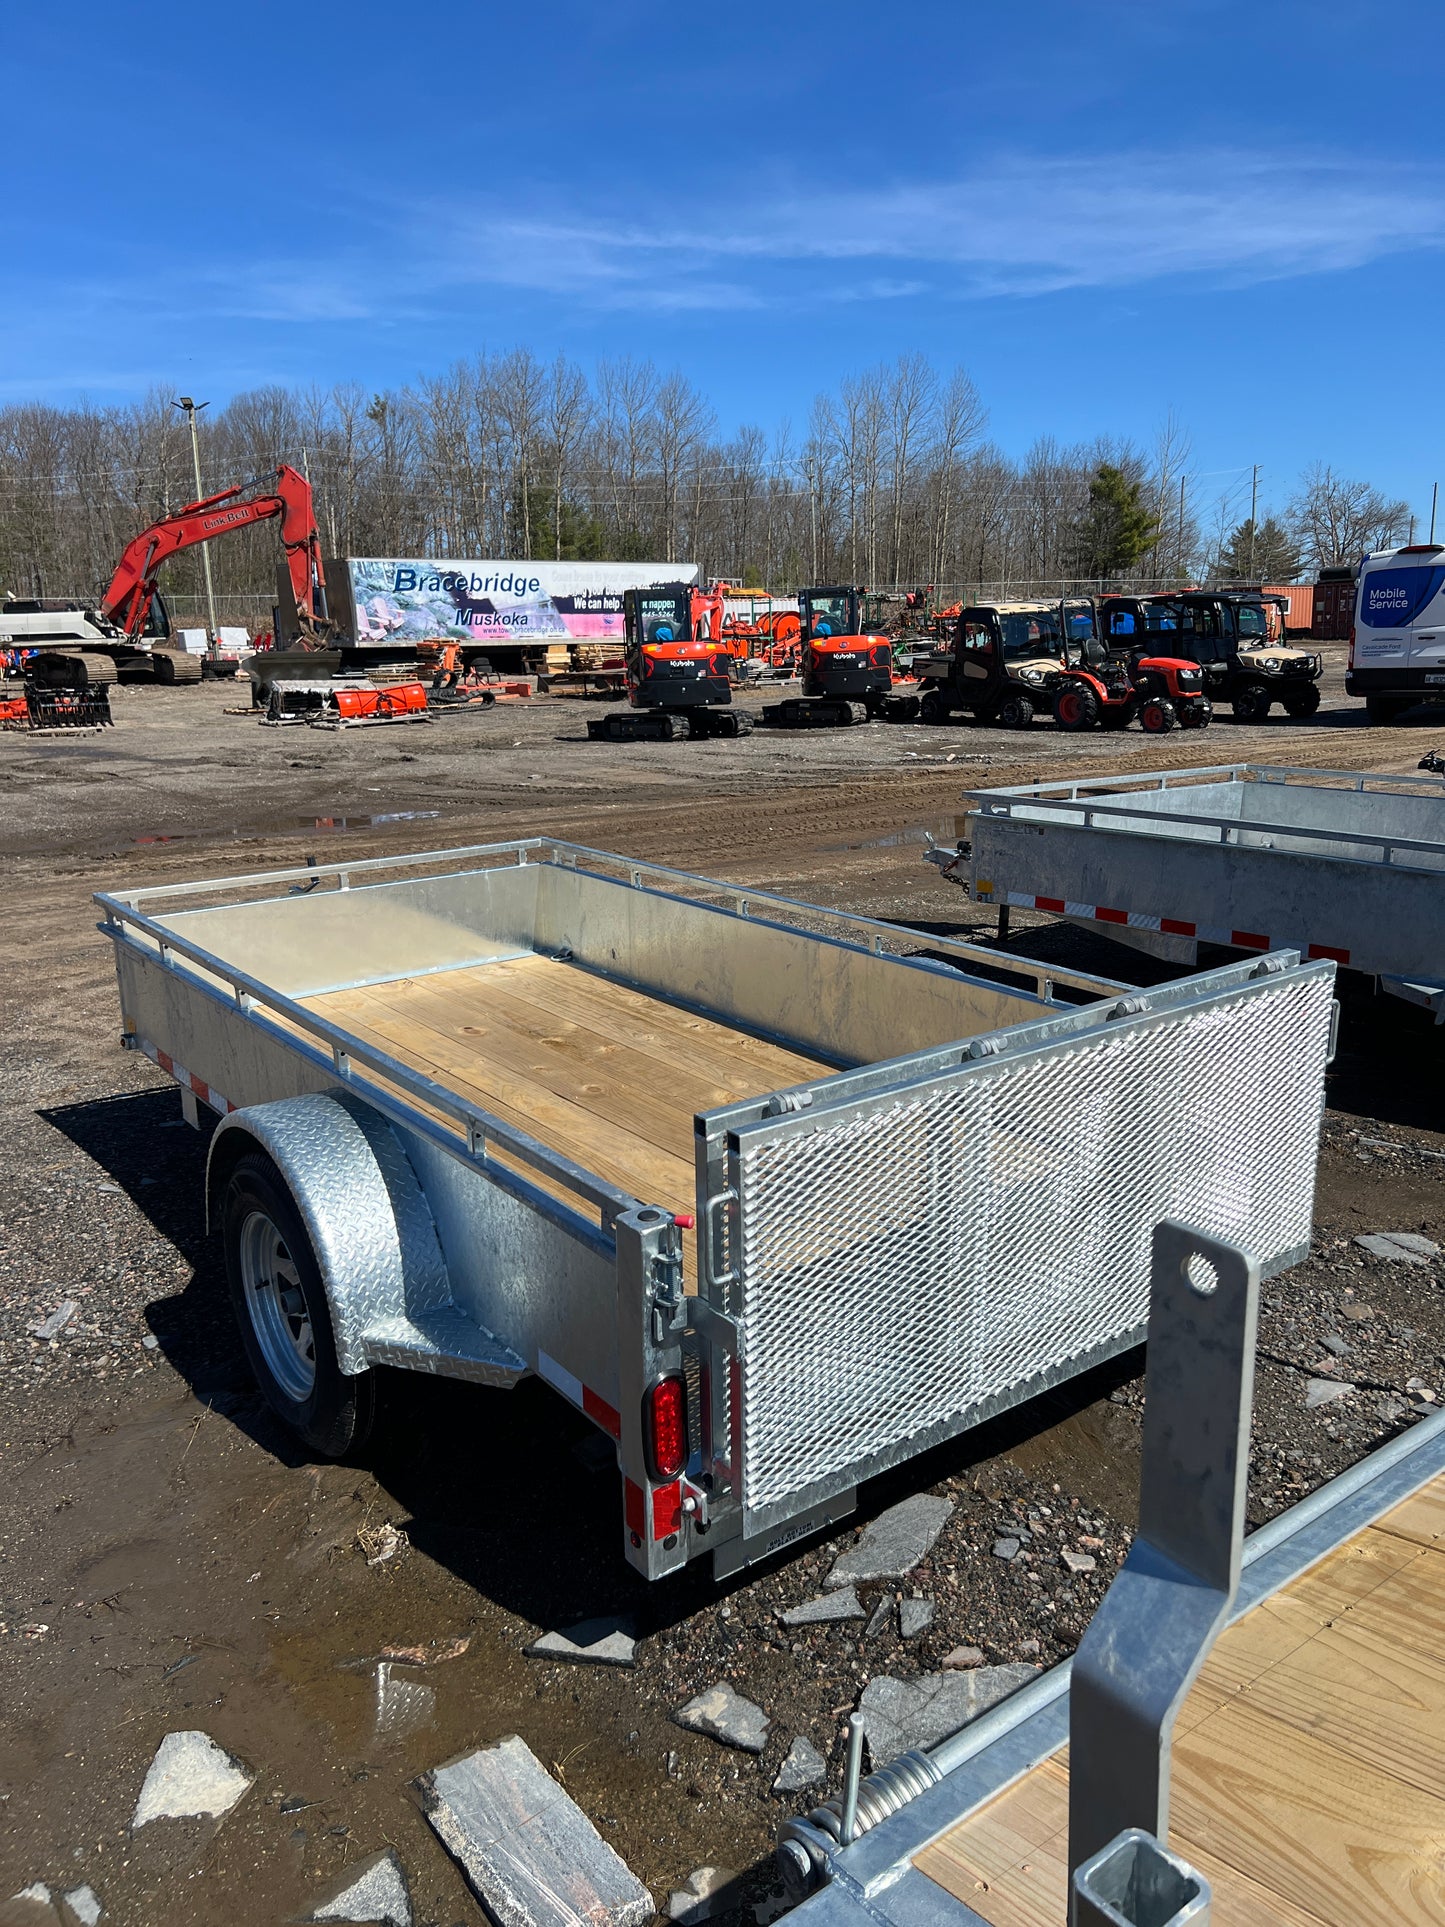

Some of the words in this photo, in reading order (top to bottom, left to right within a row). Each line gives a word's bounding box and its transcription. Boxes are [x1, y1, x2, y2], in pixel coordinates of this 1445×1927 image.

[203, 509, 249, 531] Link-Belt
[394, 568, 540, 597] Bracebridge
[1370, 588, 1406, 600] Mobile
[574, 597, 587, 609] We
[588, 599, 602, 609] can
[603, 597, 620, 612] help
[1369, 599, 1408, 609] Service
[455, 608, 528, 626] Muskoka
[833, 652, 856, 660] Kubota
